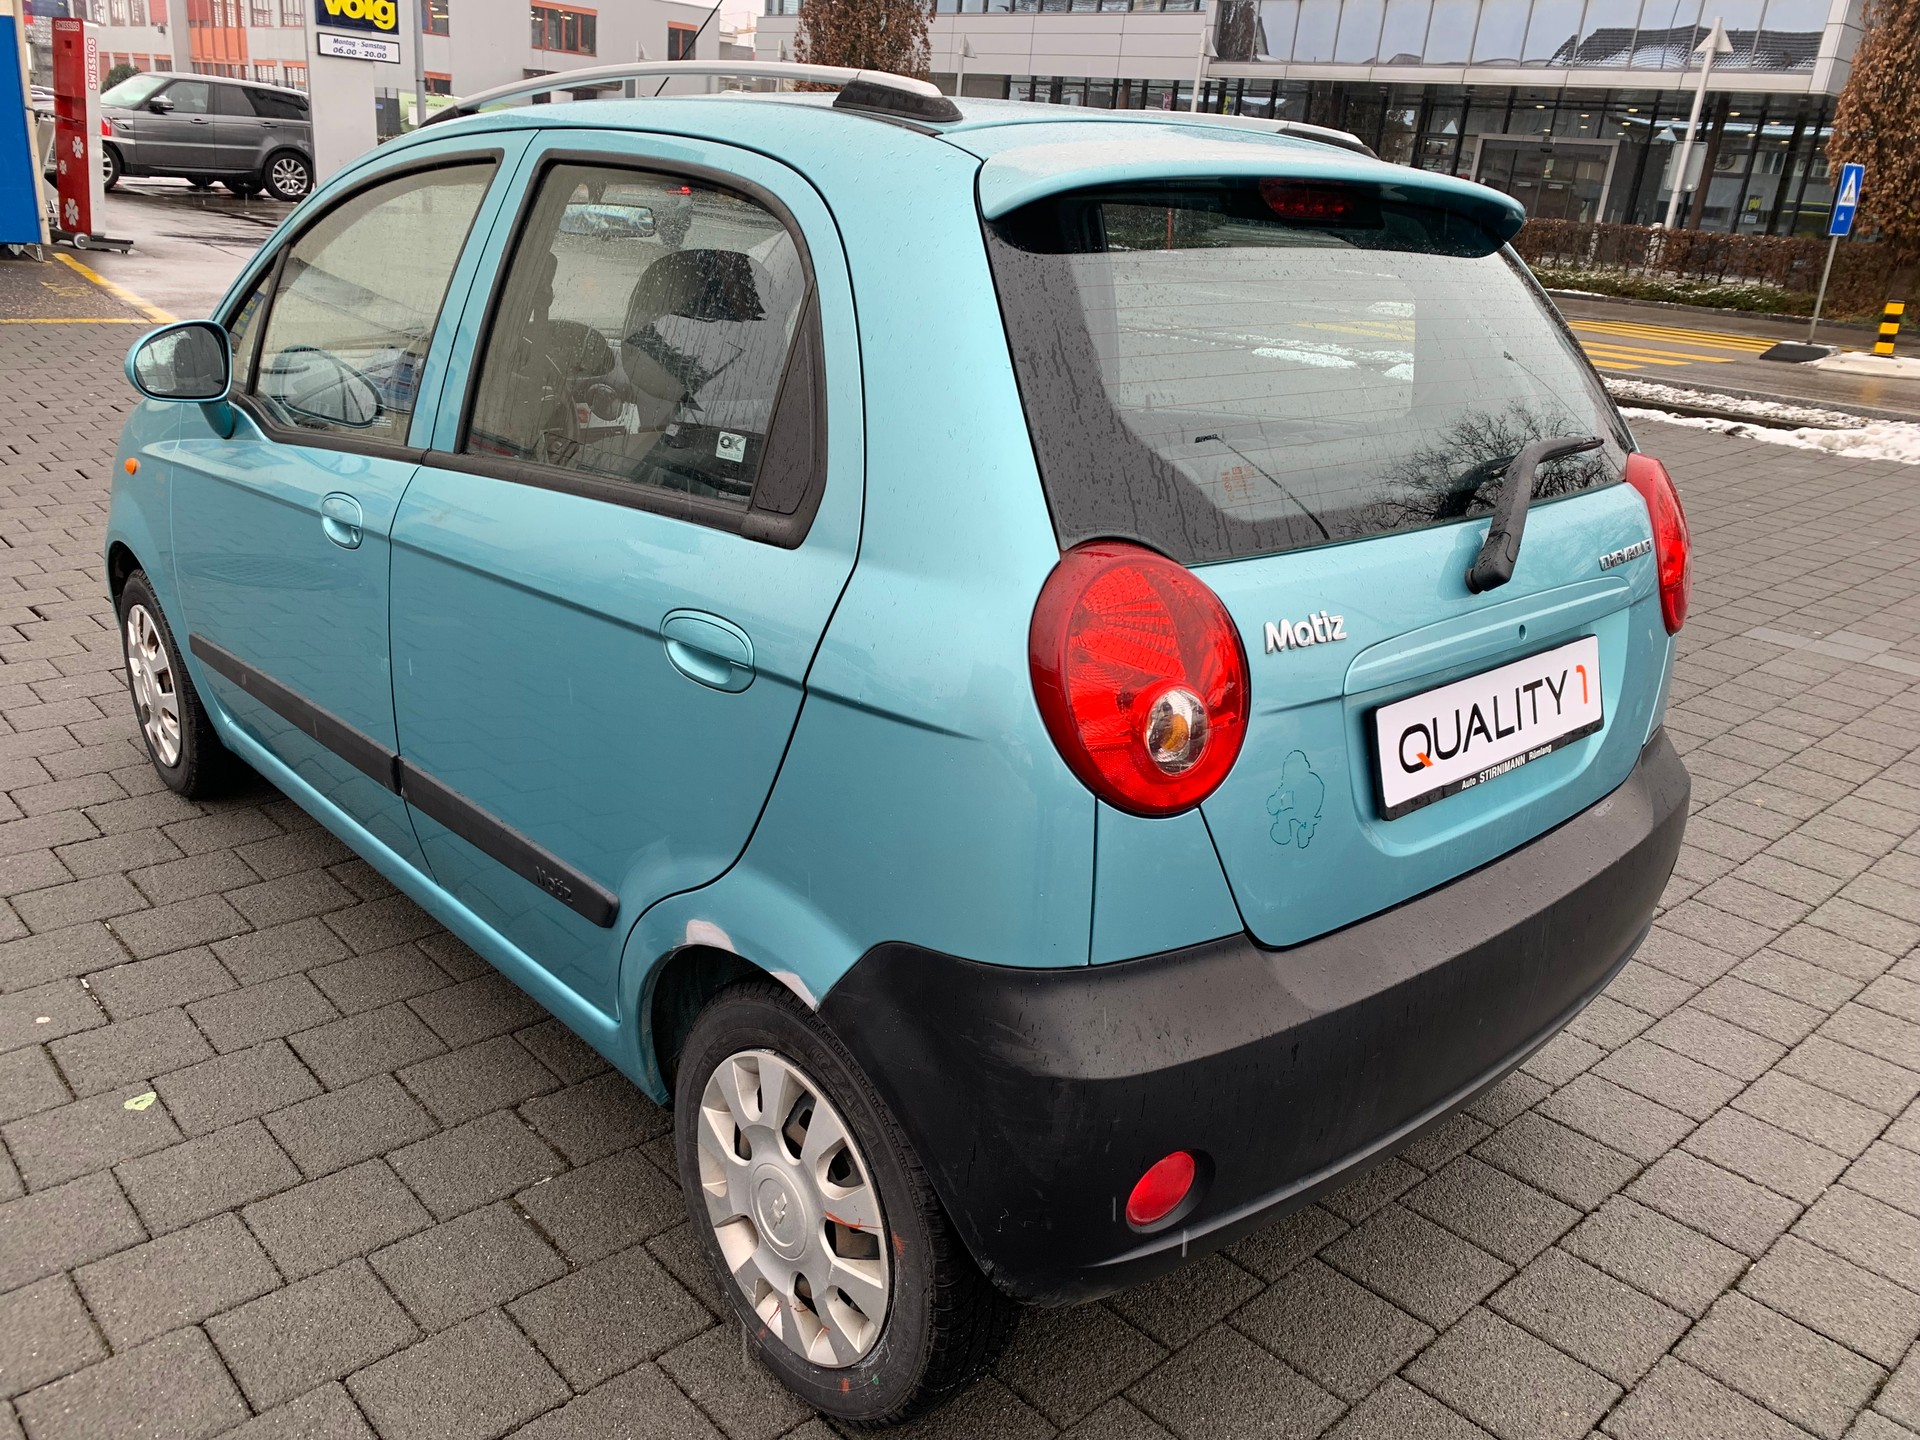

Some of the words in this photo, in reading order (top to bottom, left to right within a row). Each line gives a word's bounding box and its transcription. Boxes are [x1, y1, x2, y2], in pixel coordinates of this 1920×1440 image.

[87, 37, 97, 90] SWISSLOS
[333, 38, 355, 47] Montag
[361, 41, 386, 50] Samstag
[333, 46, 357, 56] 06.00
[364, 50, 387, 59] 20.00
[1264, 610, 1347, 654] Matiz
[1399, 669, 1568, 774] QUALITY
[1576, 664, 1588, 704] 1
[1461, 777, 1477, 790] Auto
[1479, 754, 1526, 783] STIRNIMANN
